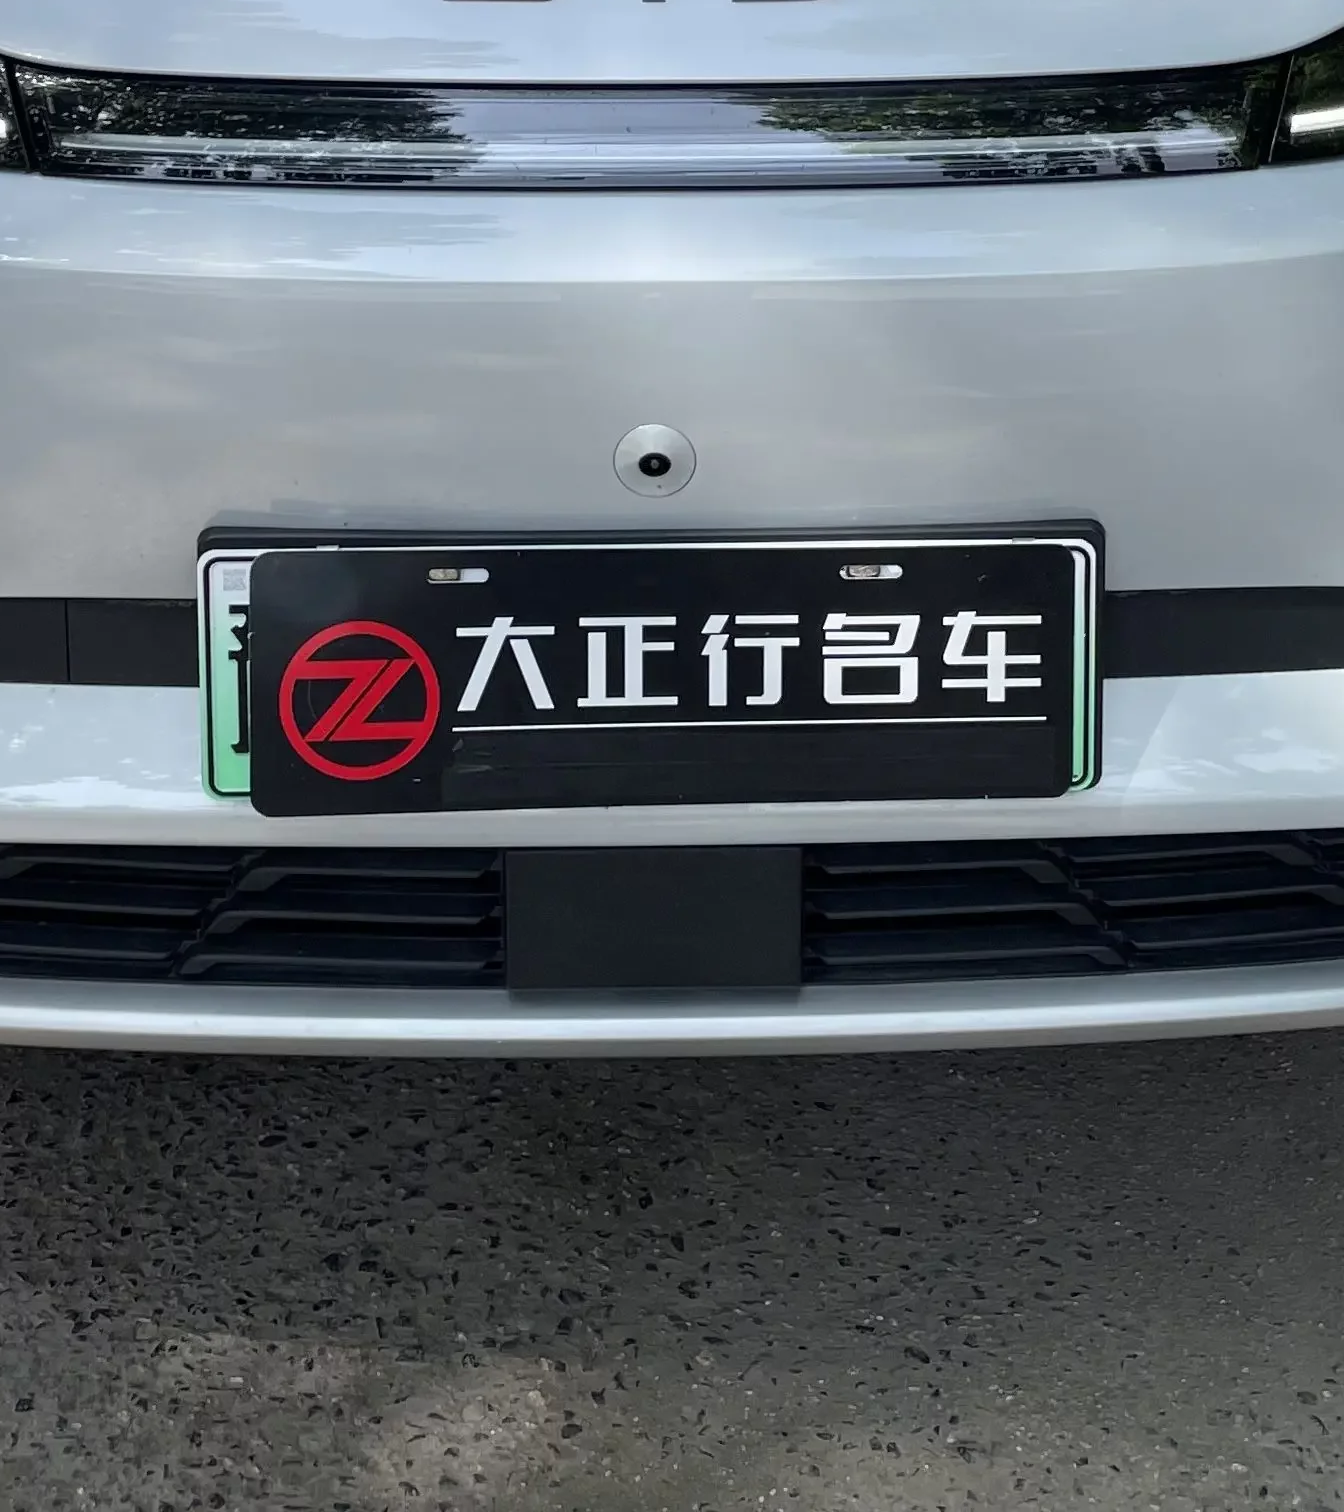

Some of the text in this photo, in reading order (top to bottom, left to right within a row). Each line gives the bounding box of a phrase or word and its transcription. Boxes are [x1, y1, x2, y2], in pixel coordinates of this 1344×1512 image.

[453, 609, 1044, 713] 大正行名车
